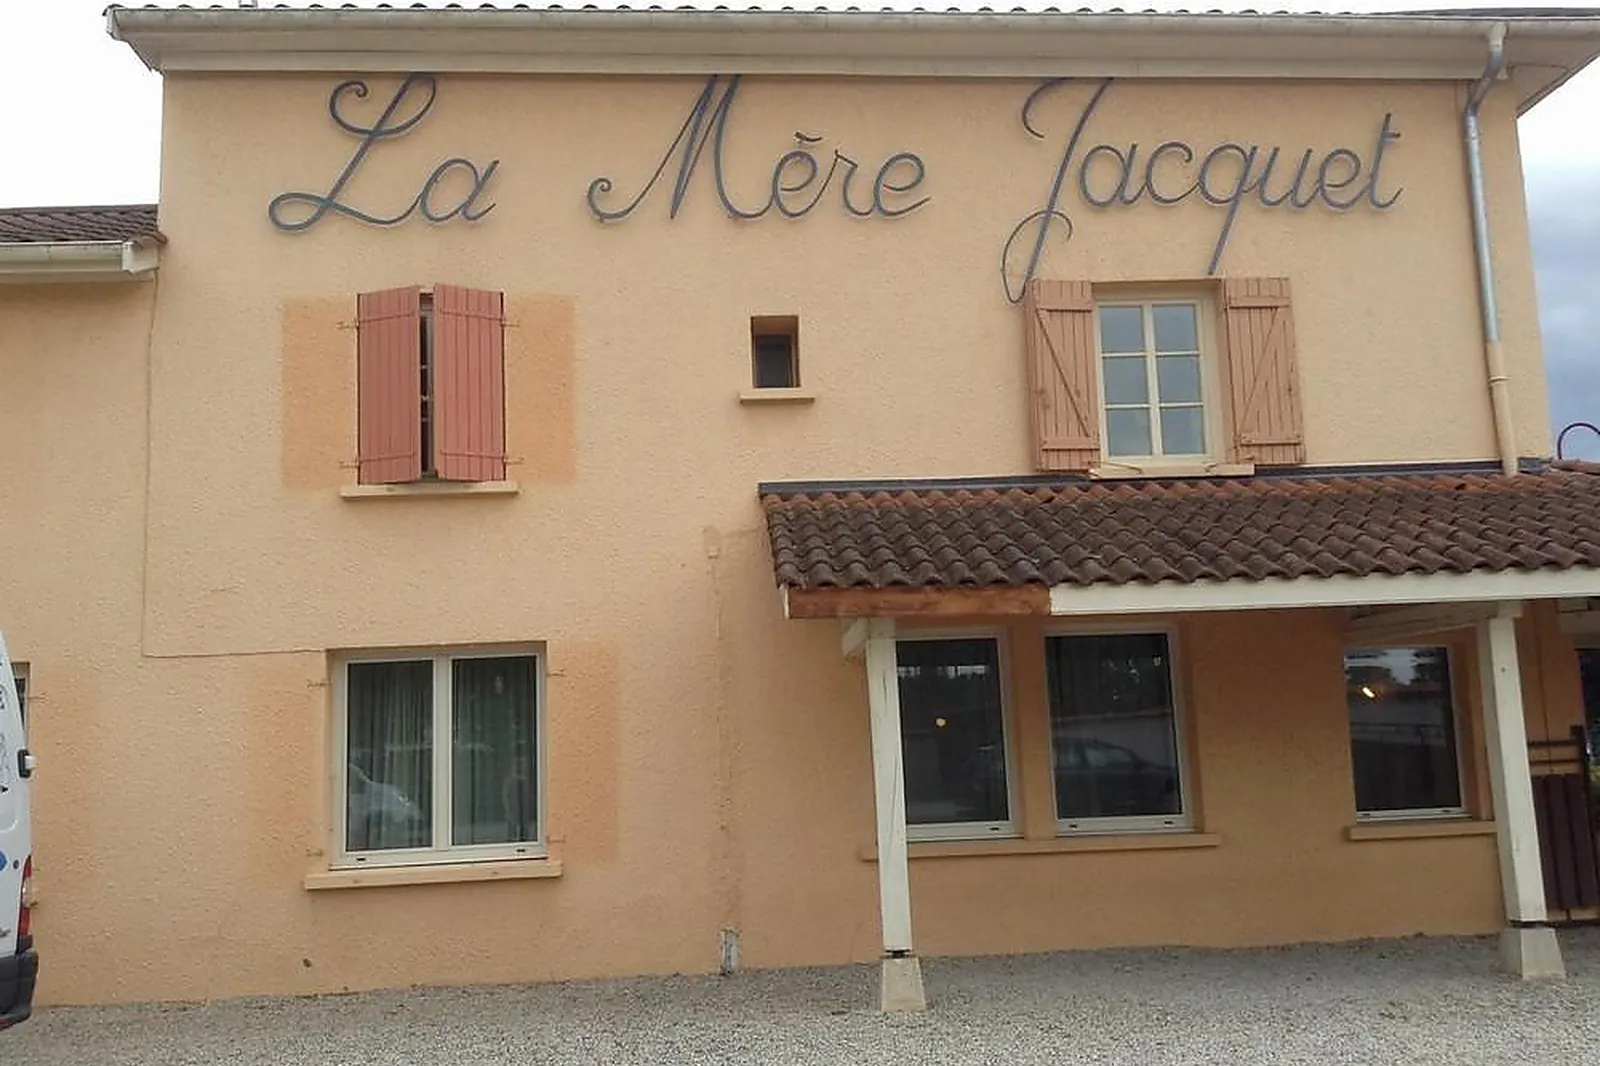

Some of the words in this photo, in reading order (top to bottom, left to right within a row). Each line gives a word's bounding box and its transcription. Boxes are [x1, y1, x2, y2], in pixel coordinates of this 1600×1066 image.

[269, 72, 500, 231] La
[586, 74, 931, 220] Mère
[1001, 77, 1403, 303] Jacquet
